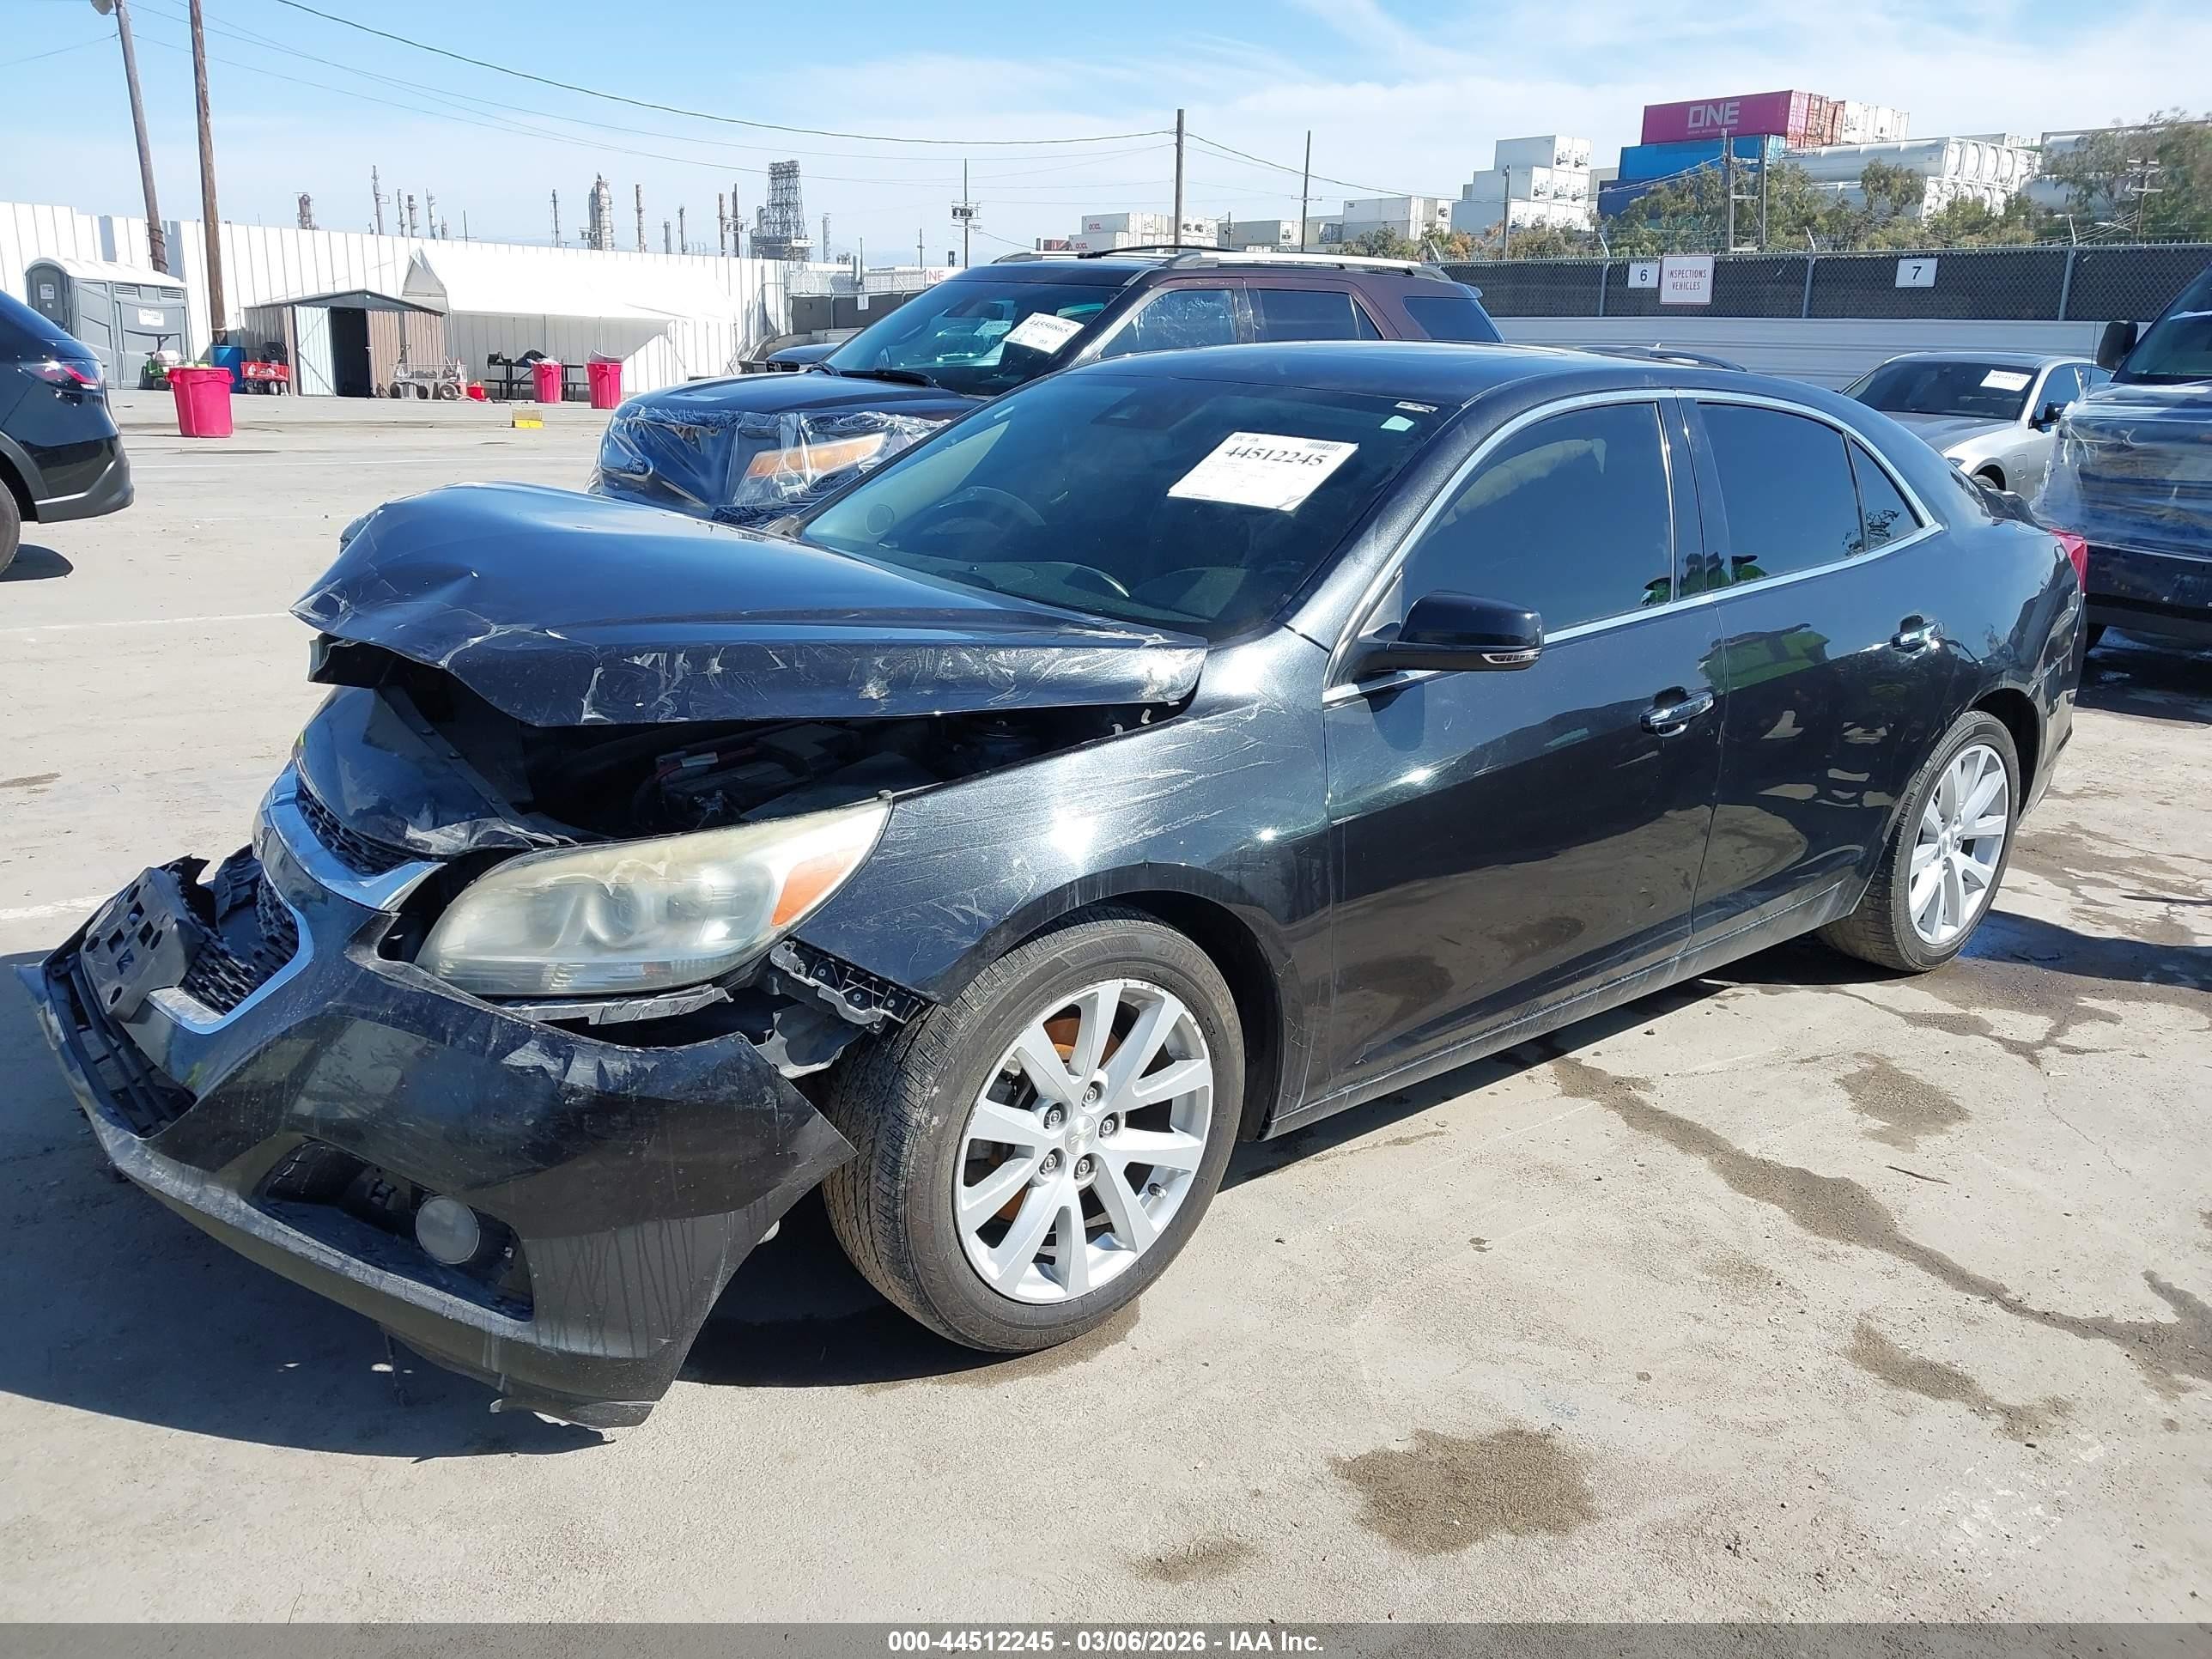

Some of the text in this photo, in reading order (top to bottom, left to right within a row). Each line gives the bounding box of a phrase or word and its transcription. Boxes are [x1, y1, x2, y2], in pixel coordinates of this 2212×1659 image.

[1687, 101, 1741, 129] ONE
[1639, 269, 1649, 282] 6
[1668, 269, 1707, 278] INSPECTIONS
[1912, 265, 1923, 280] 7
[1671, 281, 1701, 290] VEHICLES
[1224, 446, 1328, 466] 44512245
